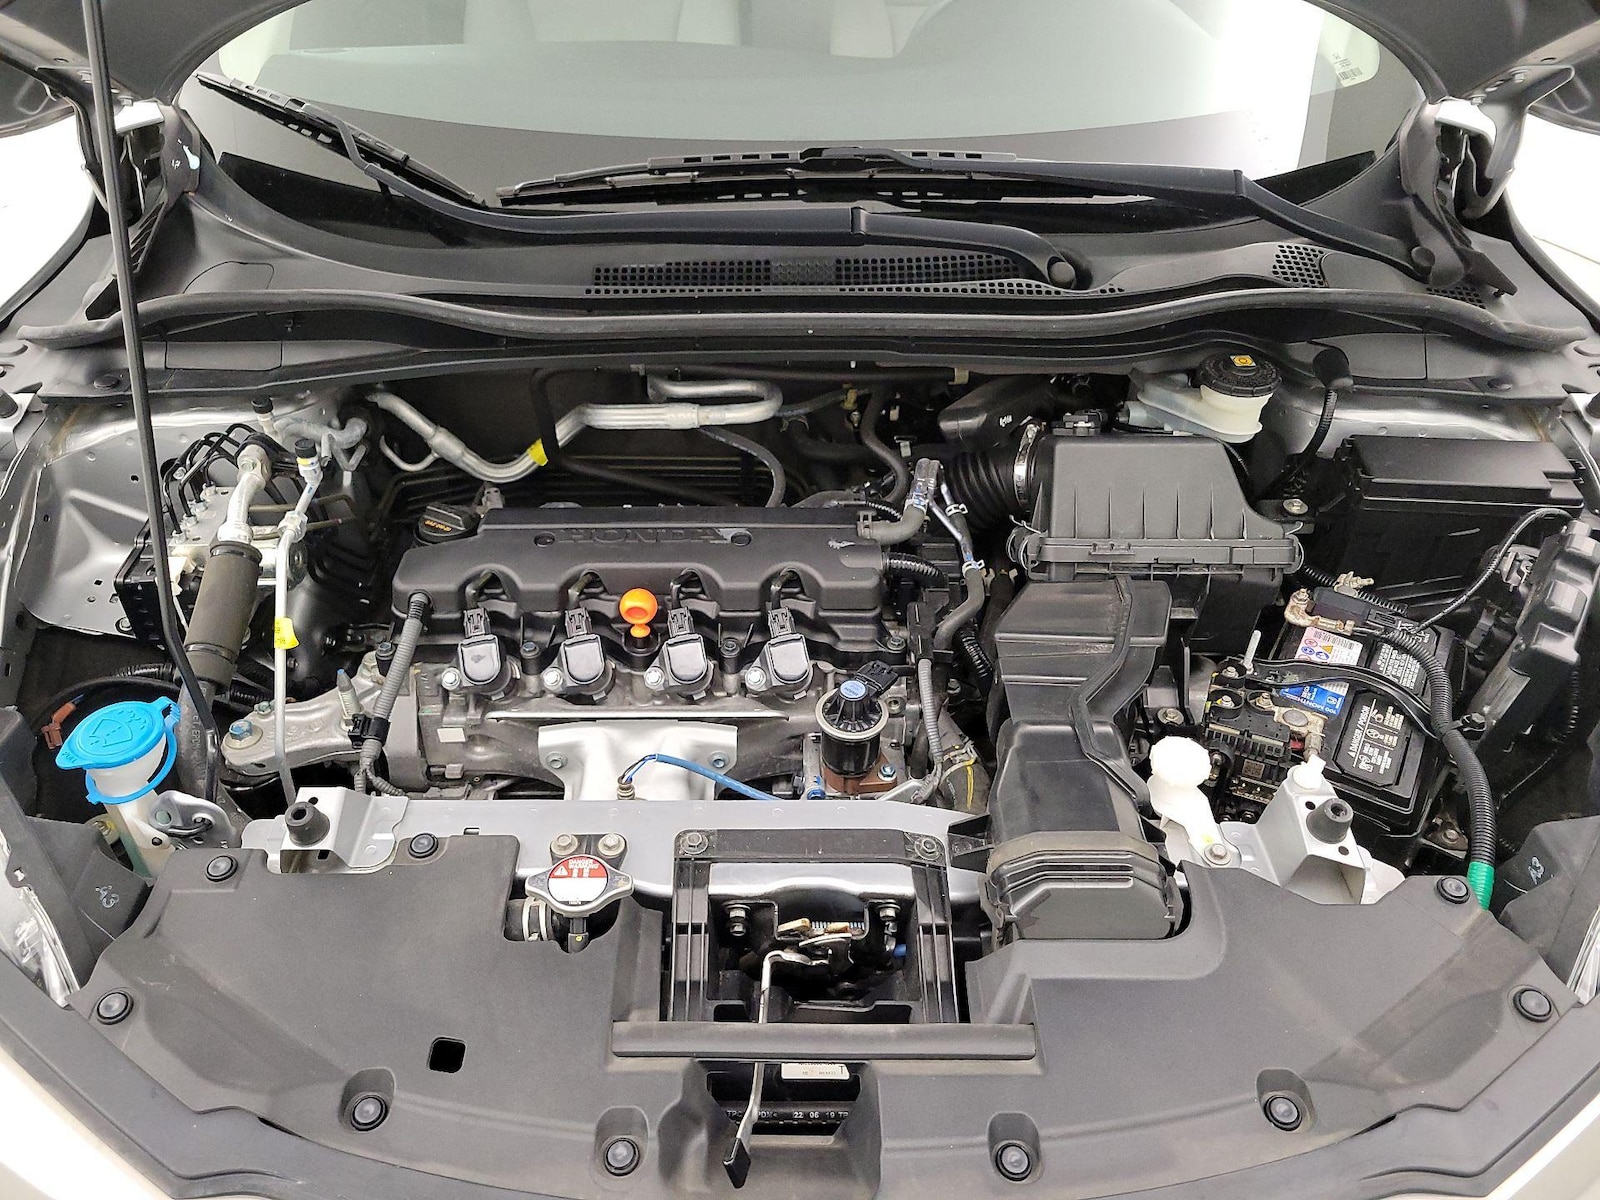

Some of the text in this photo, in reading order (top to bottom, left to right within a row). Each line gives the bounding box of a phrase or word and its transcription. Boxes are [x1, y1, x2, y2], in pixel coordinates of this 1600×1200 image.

[558, 528, 729, 544] HONDA
[1349, 728, 1362, 751] DANGER
[1357, 704, 1370, 725] POISON
[793, 1109, 804, 1119] 22
